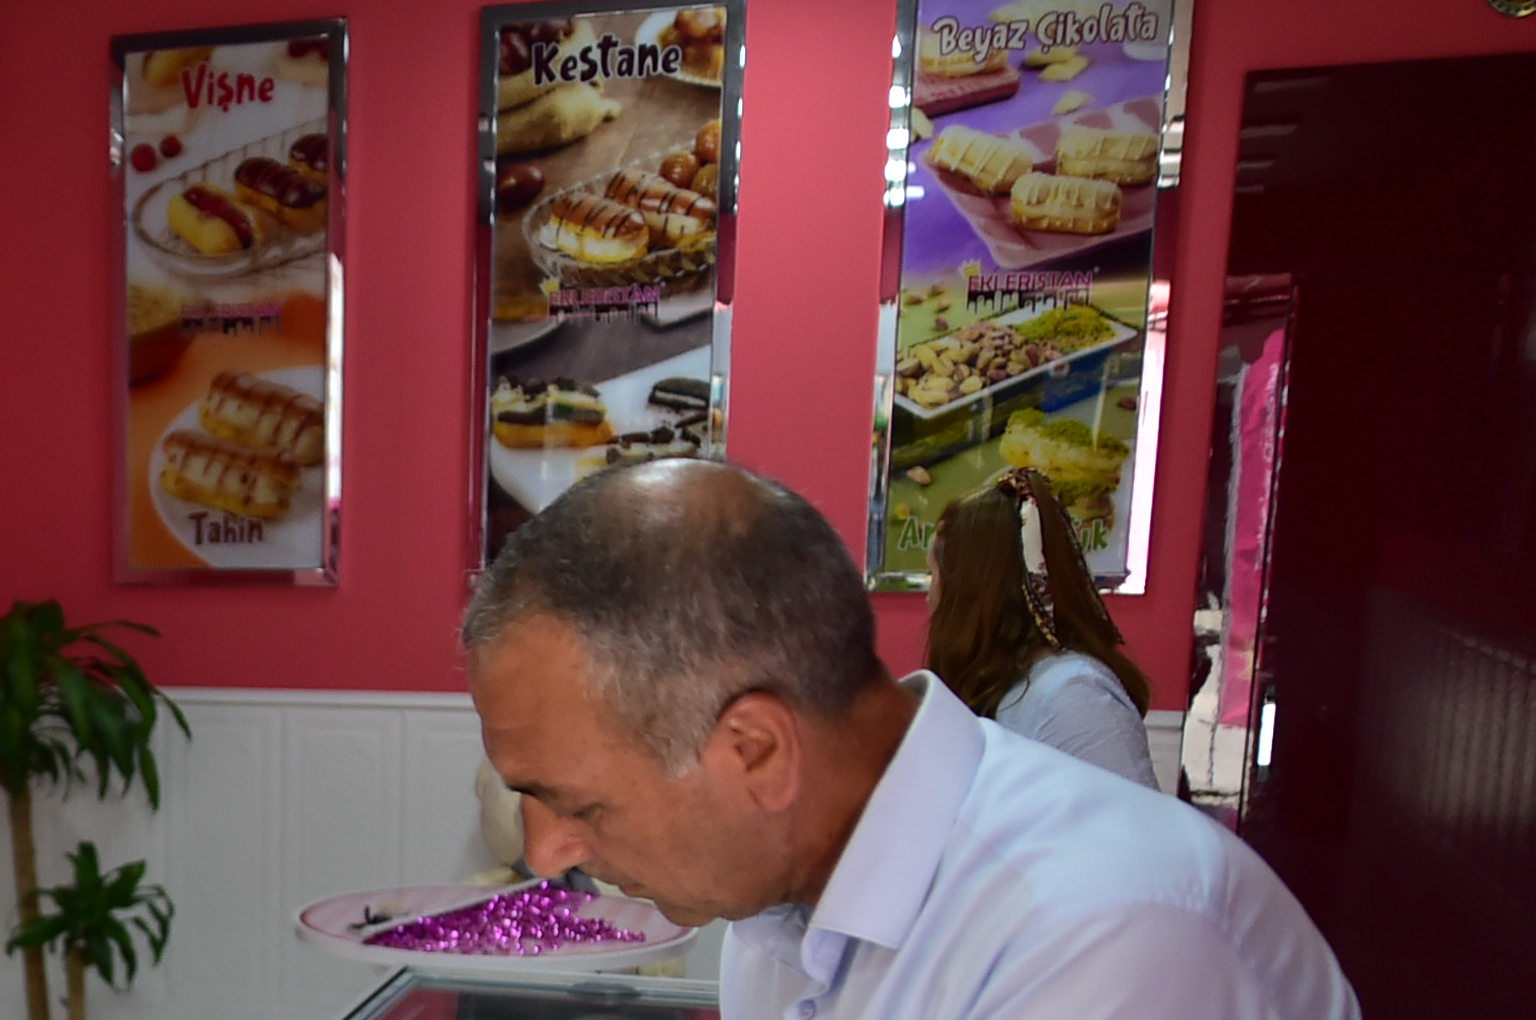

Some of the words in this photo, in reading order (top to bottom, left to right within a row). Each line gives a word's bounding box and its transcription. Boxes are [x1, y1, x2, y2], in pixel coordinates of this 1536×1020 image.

[933, 17, 1029, 62] Beyaz
[1036, 3, 1159, 53] Çikolata
[531, 34, 682, 85] Kestane
[181, 63, 276, 113] Vişne
[188, 511, 263, 544] Tahin
